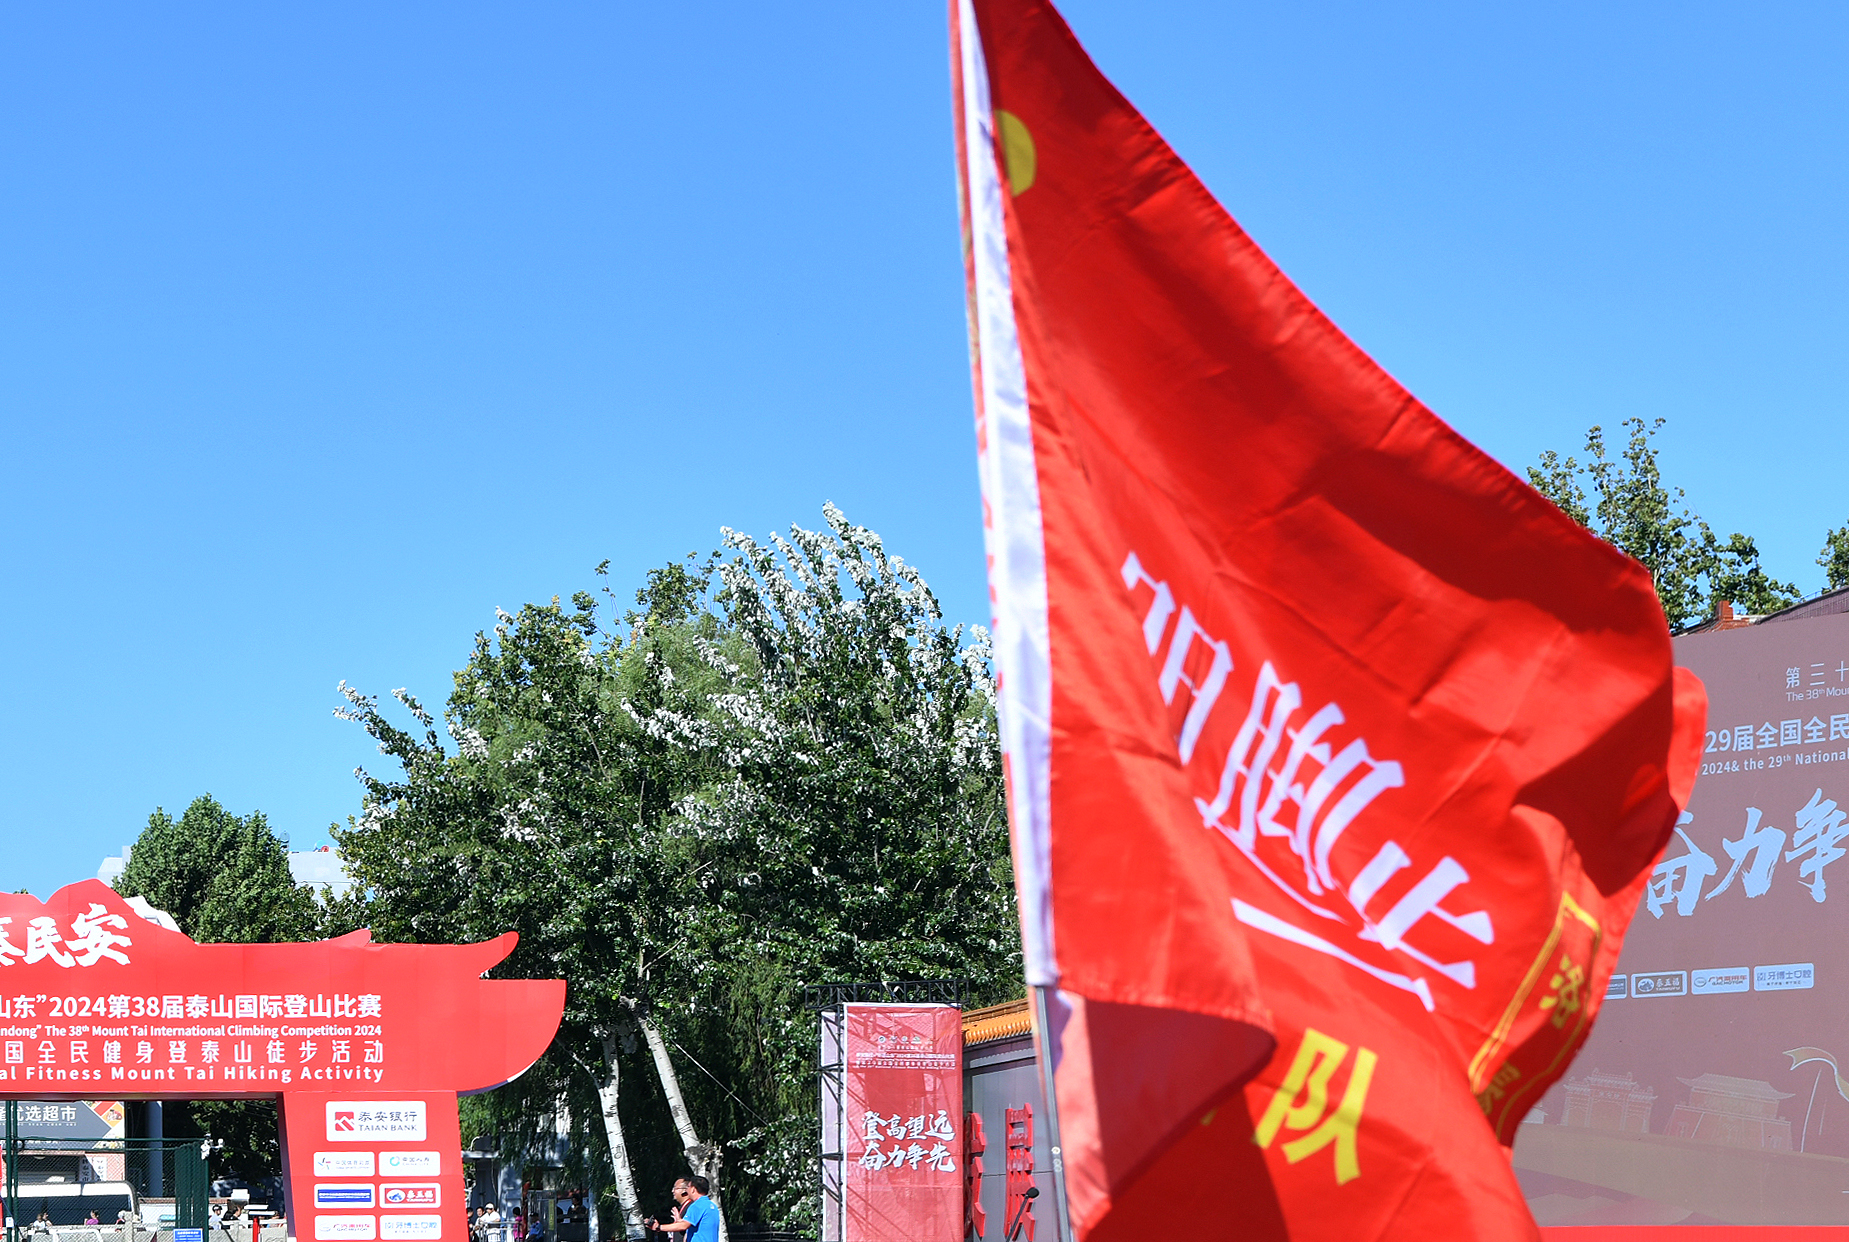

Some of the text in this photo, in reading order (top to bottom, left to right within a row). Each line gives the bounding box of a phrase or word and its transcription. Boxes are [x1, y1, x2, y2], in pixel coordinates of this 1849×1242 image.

[1786, 692, 1803, 702] The
[1744, 758, 1764, 771] the
[45, 1025, 66, 1036] The
[69, 1025, 90, 1036] 38th
[92, 1025, 128, 1036] Mount
[131, 1025, 147, 1036] Tai
[151, 1025, 225, 1037] International
[227, 1025, 279, 1038] Climbing
[281, 1025, 352, 1039] Competition
[354, 1025, 382, 1036] 2024
[26, 1066, 102, 1080] Fitness
[111, 1067, 175, 1080] Mount
[184, 1067, 214, 1080] Tai
[224, 1066, 292, 1083] Hiking
[301, 1066, 384, 1083] Activity
[358, 1111, 417, 1122] 泰安银行
[862, 1109, 956, 1141] 登高望远
[858, 1141, 956, 1172] 奋力争先
